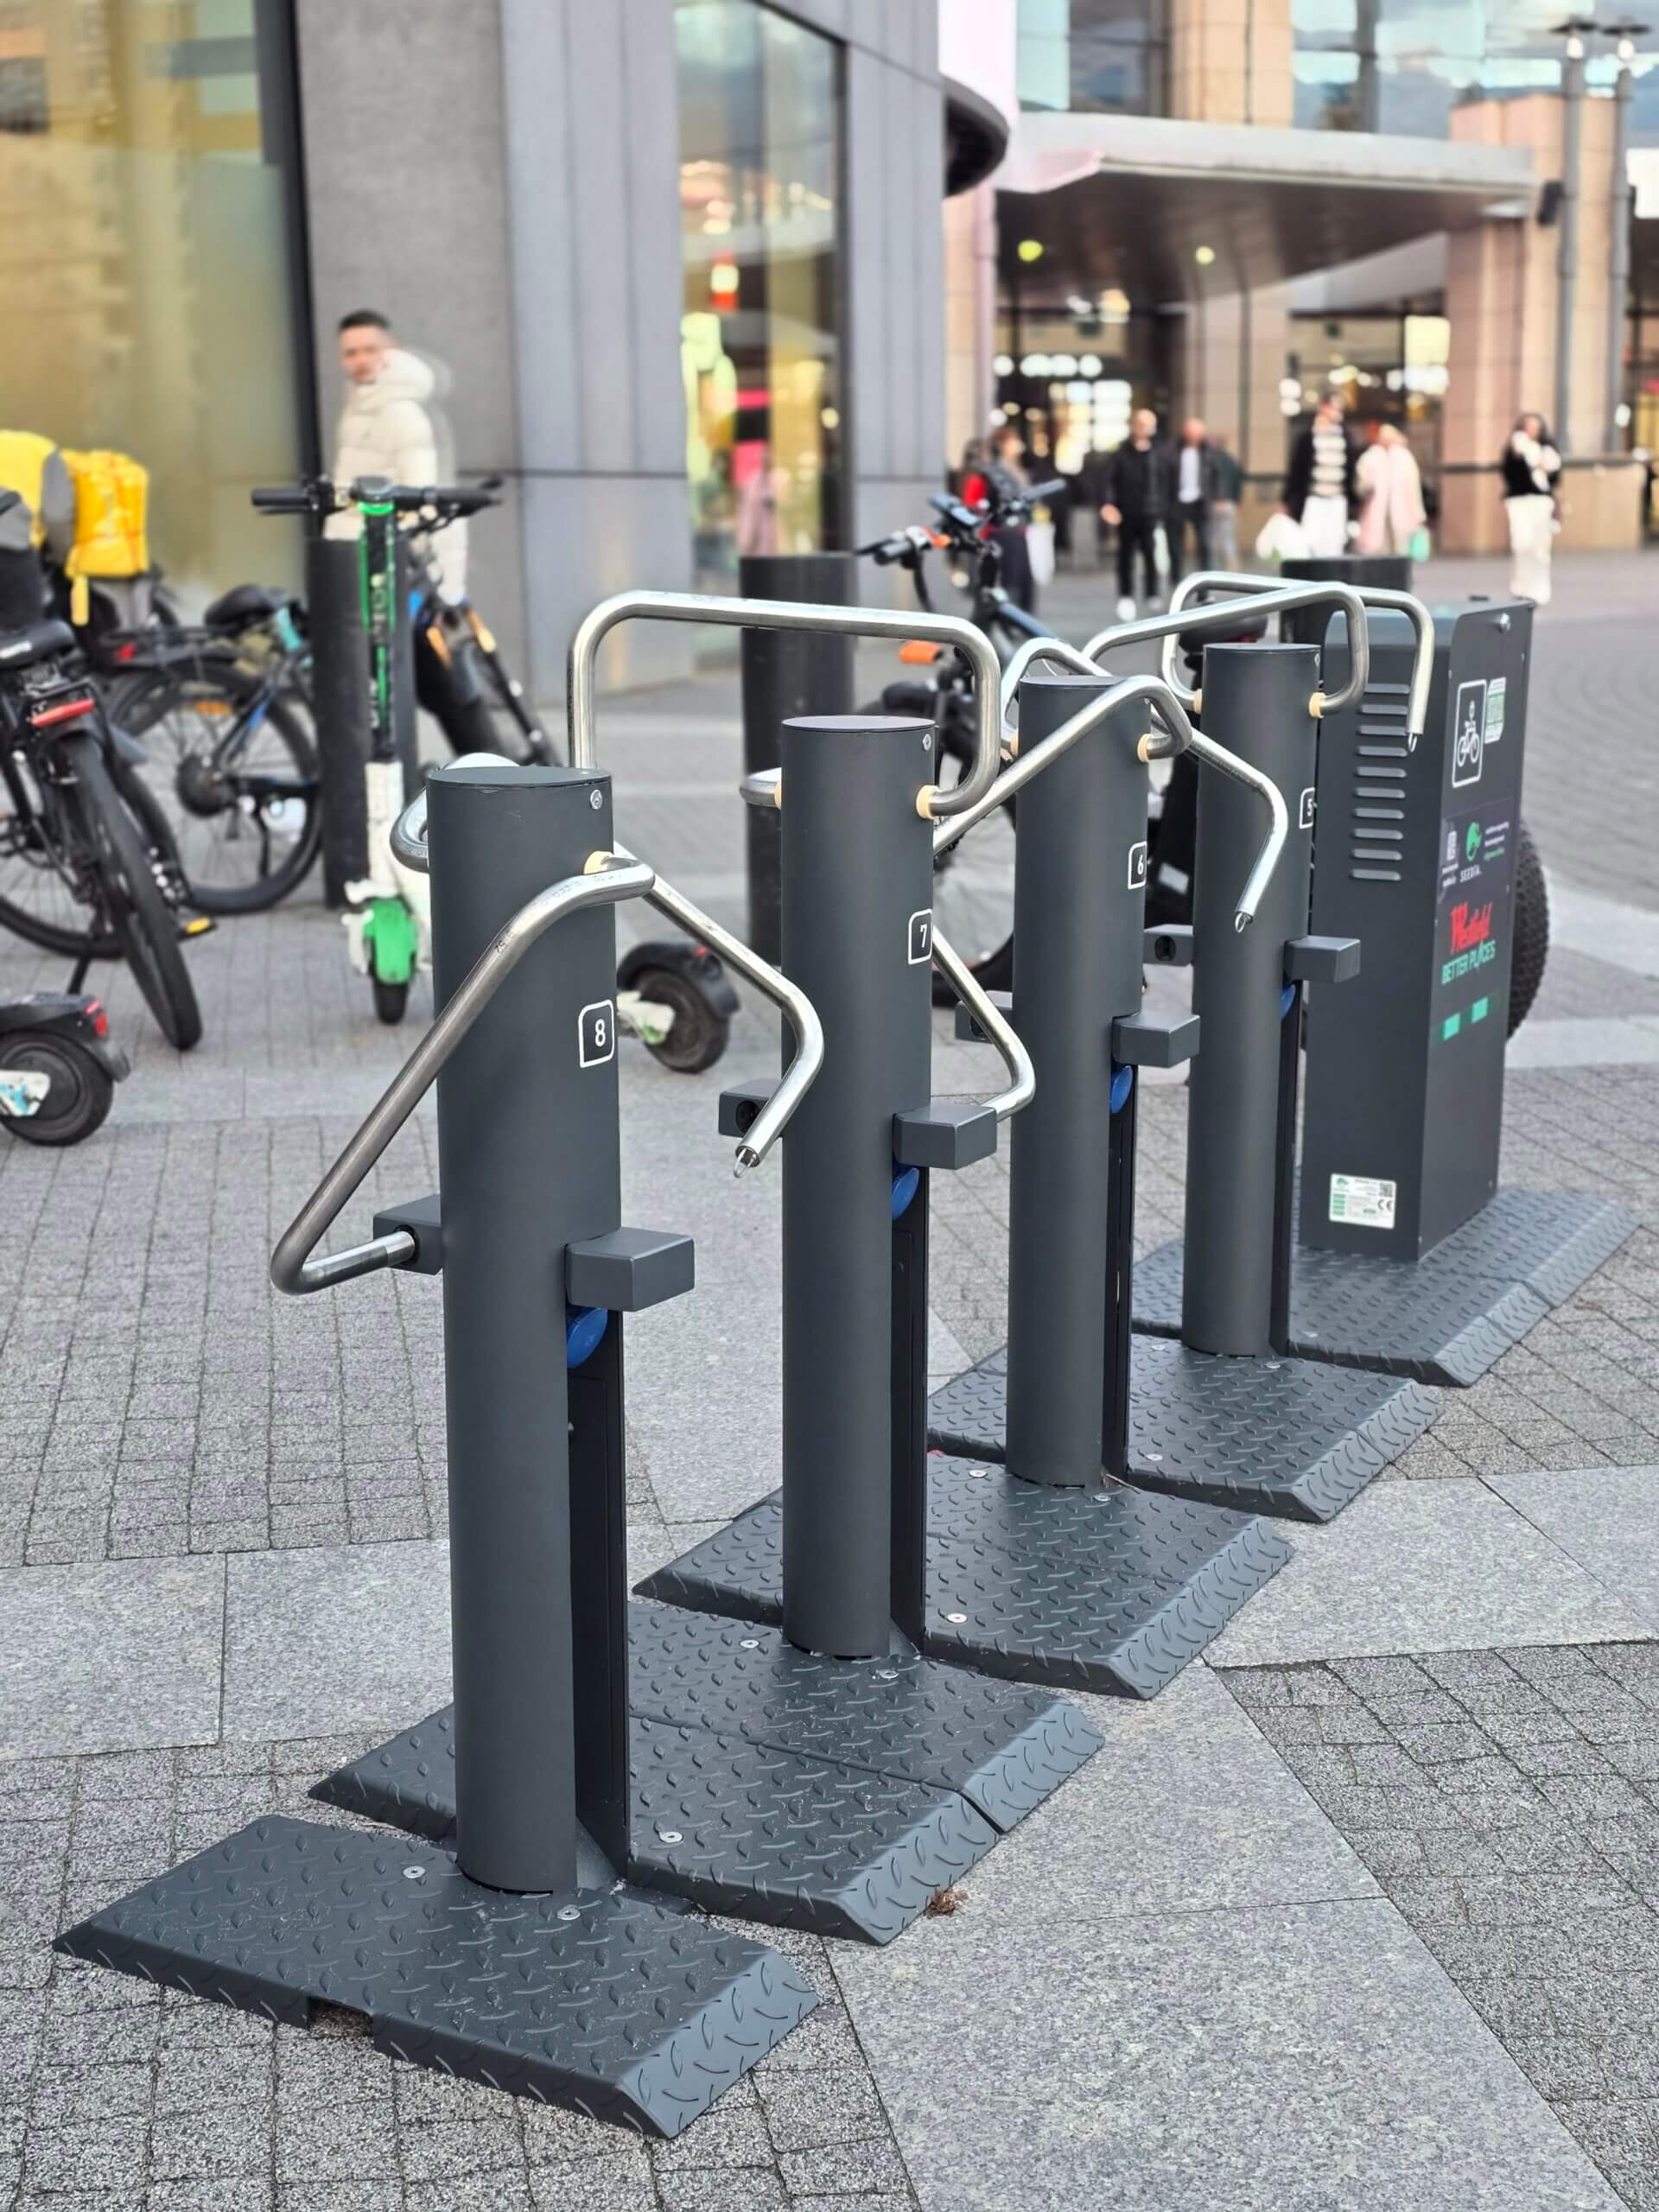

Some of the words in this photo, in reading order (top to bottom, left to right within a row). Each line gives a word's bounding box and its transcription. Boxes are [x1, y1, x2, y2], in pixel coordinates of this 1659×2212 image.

[1137, 854, 1143, 874] 6
[920, 924, 927, 948] 7
[1441, 953, 1469, 985] BETTER
[595, 1019, 606, 1046] 8
